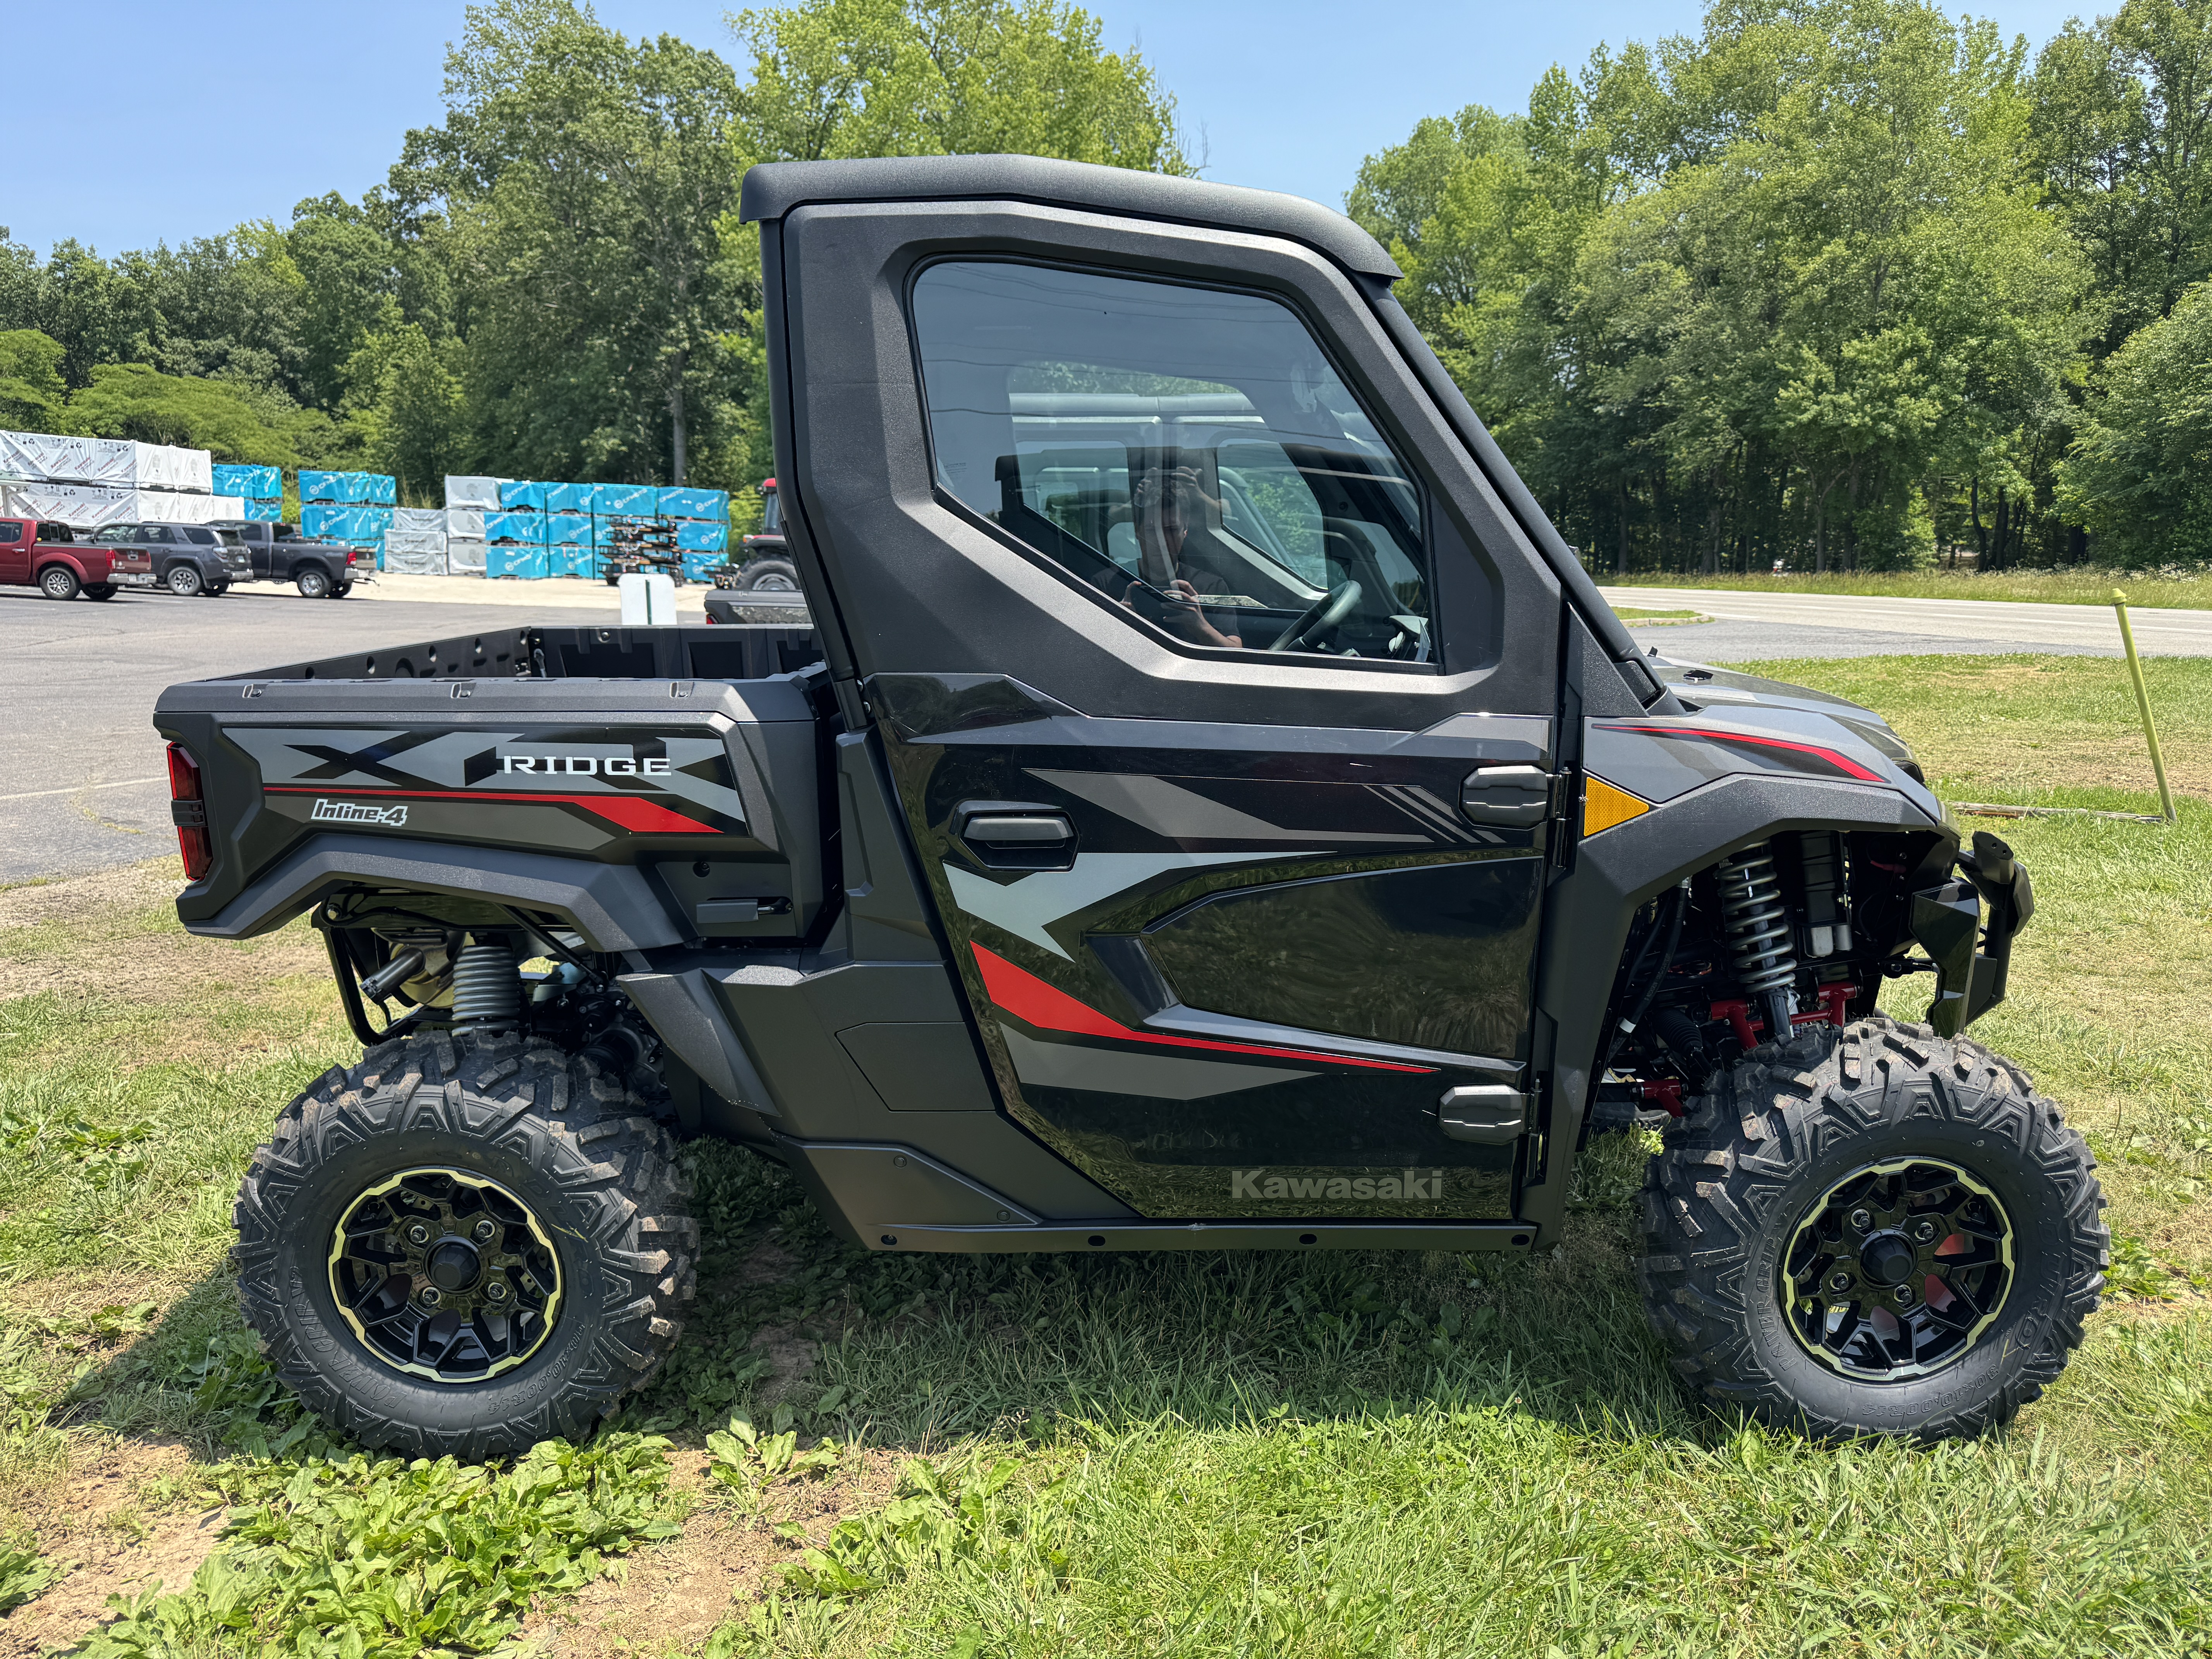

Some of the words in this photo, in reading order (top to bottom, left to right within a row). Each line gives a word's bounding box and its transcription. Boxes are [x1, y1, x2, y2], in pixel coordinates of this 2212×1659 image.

[504, 756, 672, 776] RIDGE
[311, 799, 408, 826] Inline-4
[1232, 1170, 1442, 1199] Kawasaki
[1756, 1237, 1776, 1293] GRIP
[295, 1304, 335, 1352] GRIP
[1757, 1295, 1797, 1371] POWER
[328, 1354, 407, 1408] POWER
